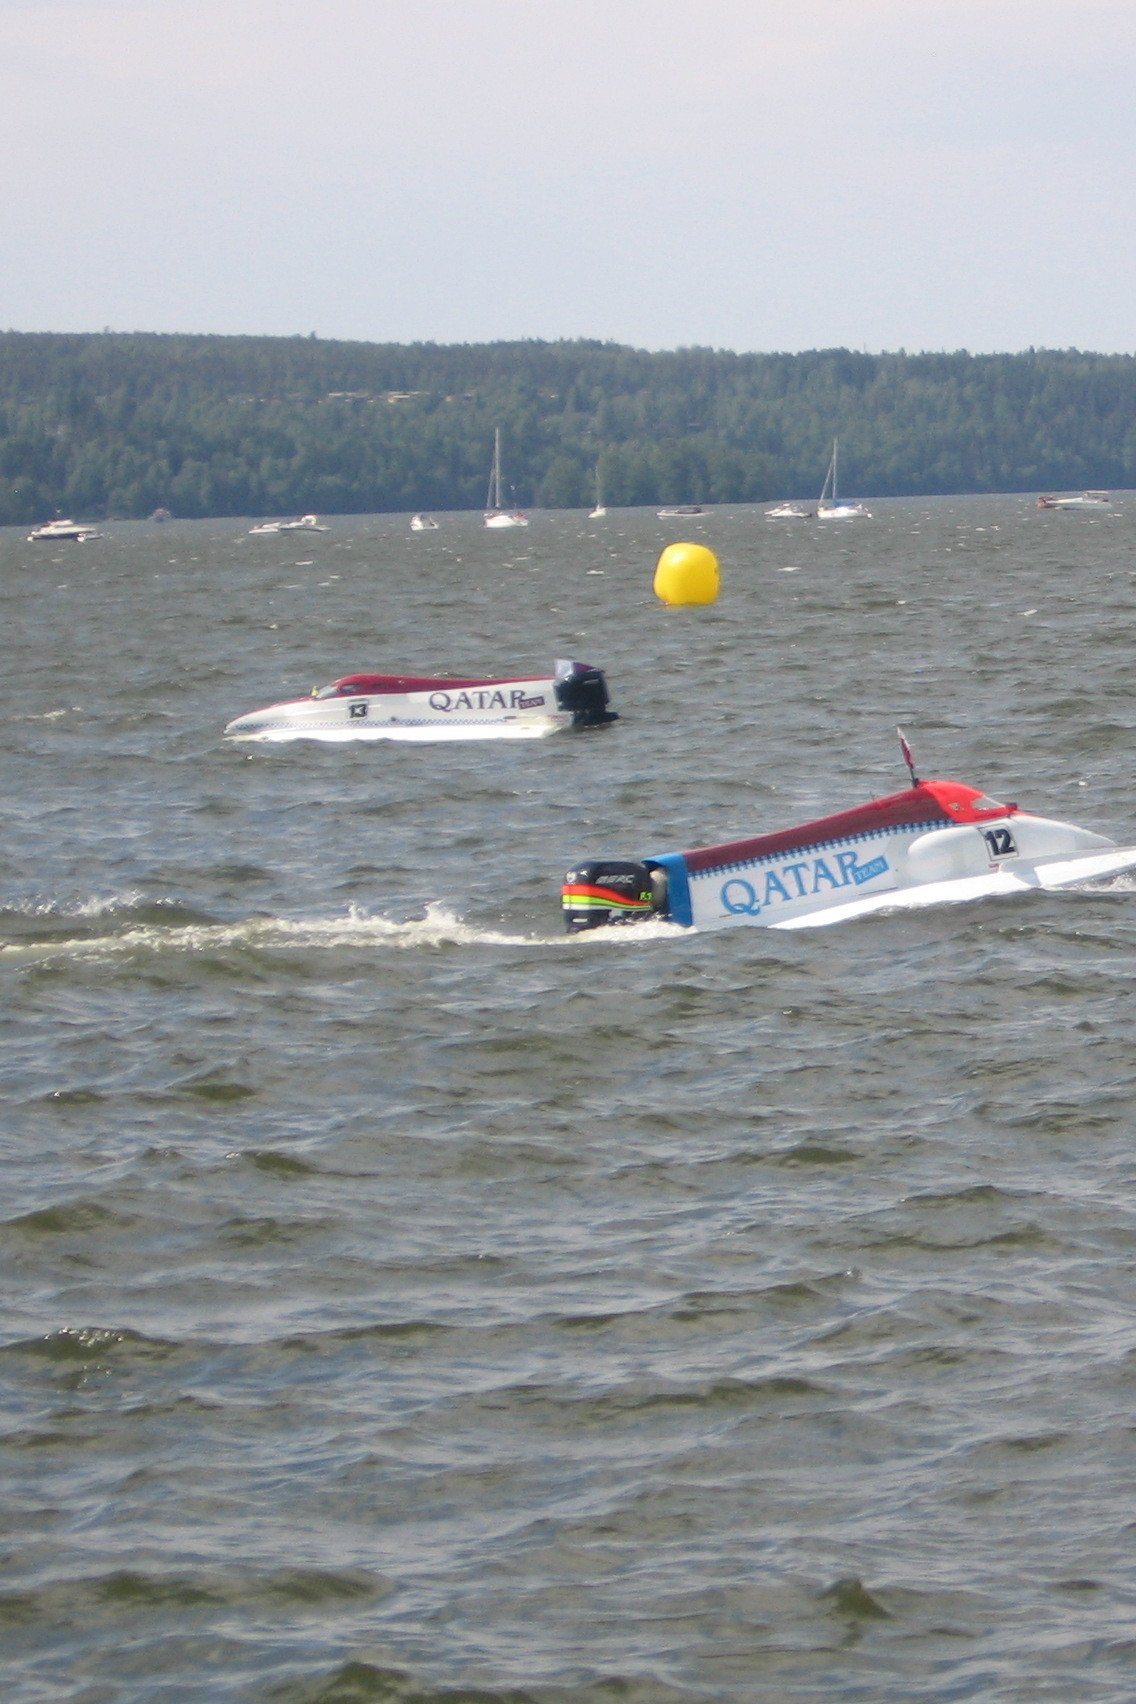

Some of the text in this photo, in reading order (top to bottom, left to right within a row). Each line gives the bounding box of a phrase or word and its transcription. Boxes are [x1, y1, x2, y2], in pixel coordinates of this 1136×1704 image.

[429, 690, 526, 712] QATAR
[985, 829, 1015, 856] 12
[720, 851, 860, 916] QATAR
